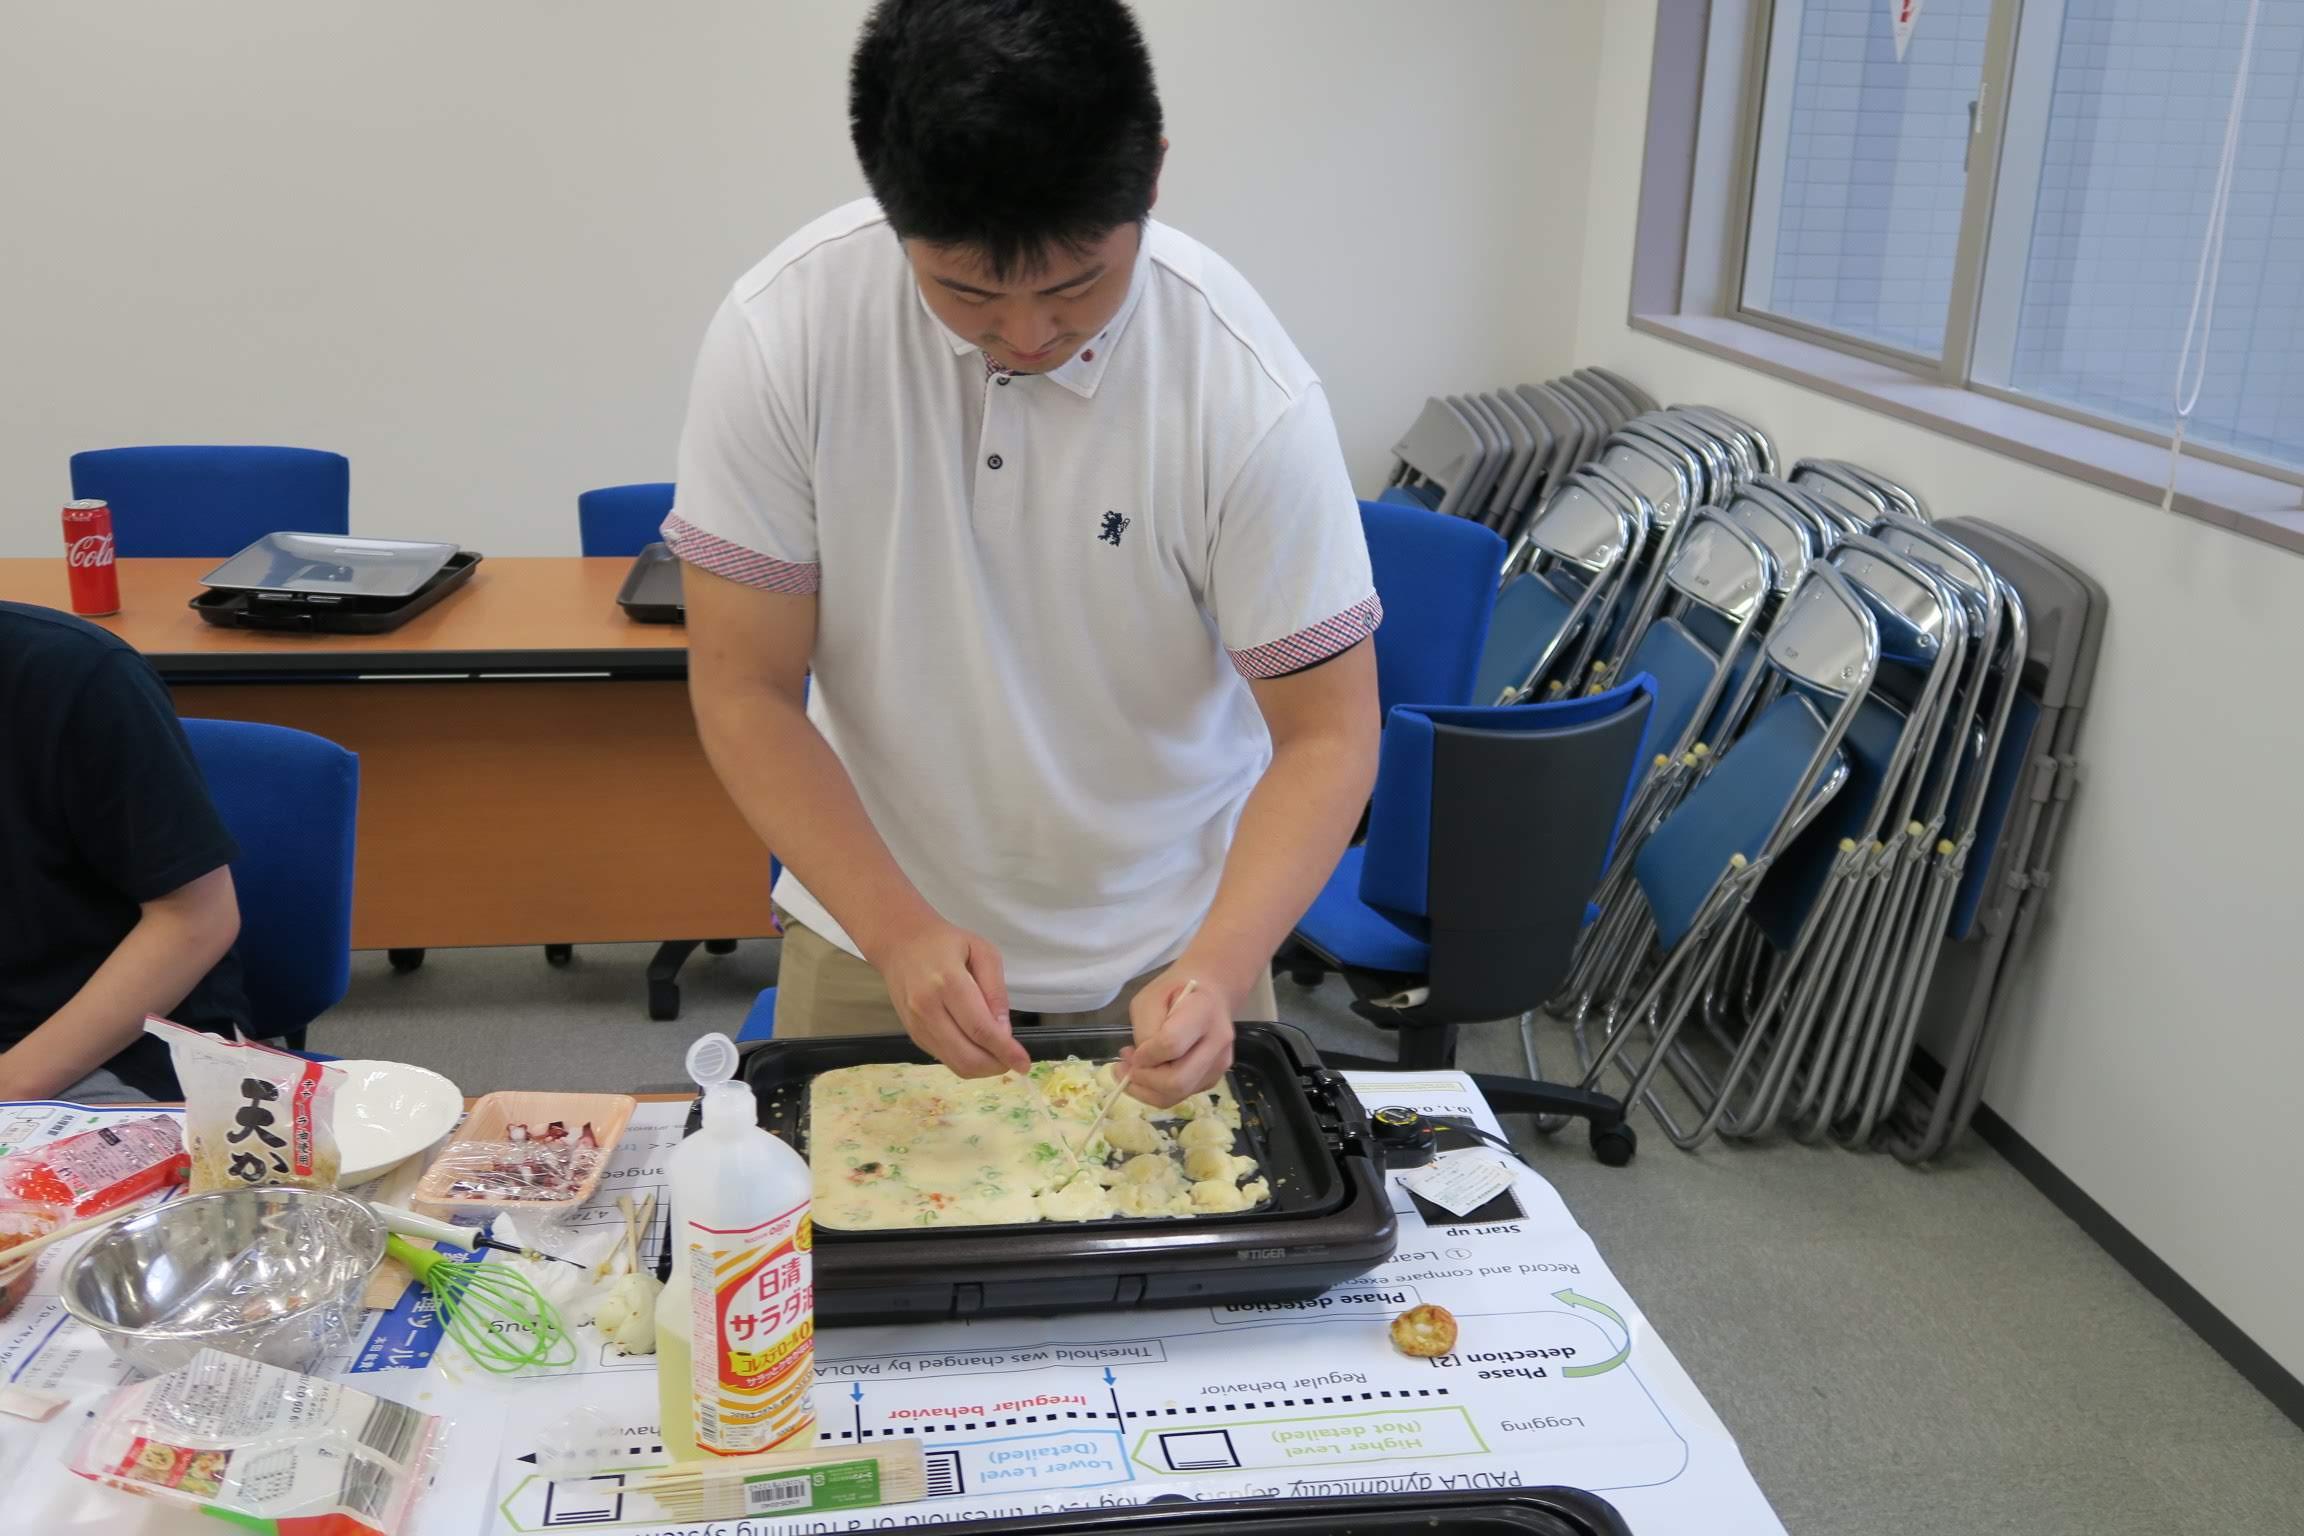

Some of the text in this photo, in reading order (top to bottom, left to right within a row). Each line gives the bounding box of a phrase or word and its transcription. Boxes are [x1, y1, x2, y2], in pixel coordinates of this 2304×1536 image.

[226, 1078, 289, 1186] 天か
[1446, 1224, 1521, 1239] Start up
[1248, 1247, 1286, 1260] TIGER
[759, 1257, 801, 1302] 日清
[1395, 1269, 1474, 1283] compare
[1479, 1265, 1512, 1278] and
[1519, 1262, 1581, 1276] Record
[1226, 1291, 1406, 1314] Phase detection
[814, 1346, 1153, 1378] Threshold was changed by PADLA
[1466, 1347, 1577, 1364] detection
[1200, 1371, 1368, 1396] Regular behavior
[1477, 1366, 1548, 1381] Phase
[888, 1395, 1087, 1422] Irregular behavior
[1271, 1420, 1422, 1443] (Not detailed)
[1500, 1416, 1585, 1434] Logging
[989, 1441, 1098, 1464] (Detailed)
[1285, 1437, 1421, 1458] Higher Level
[980, 1458, 1114, 1483] Lower Level
[1438, 1470, 1523, 1490] PADLA
